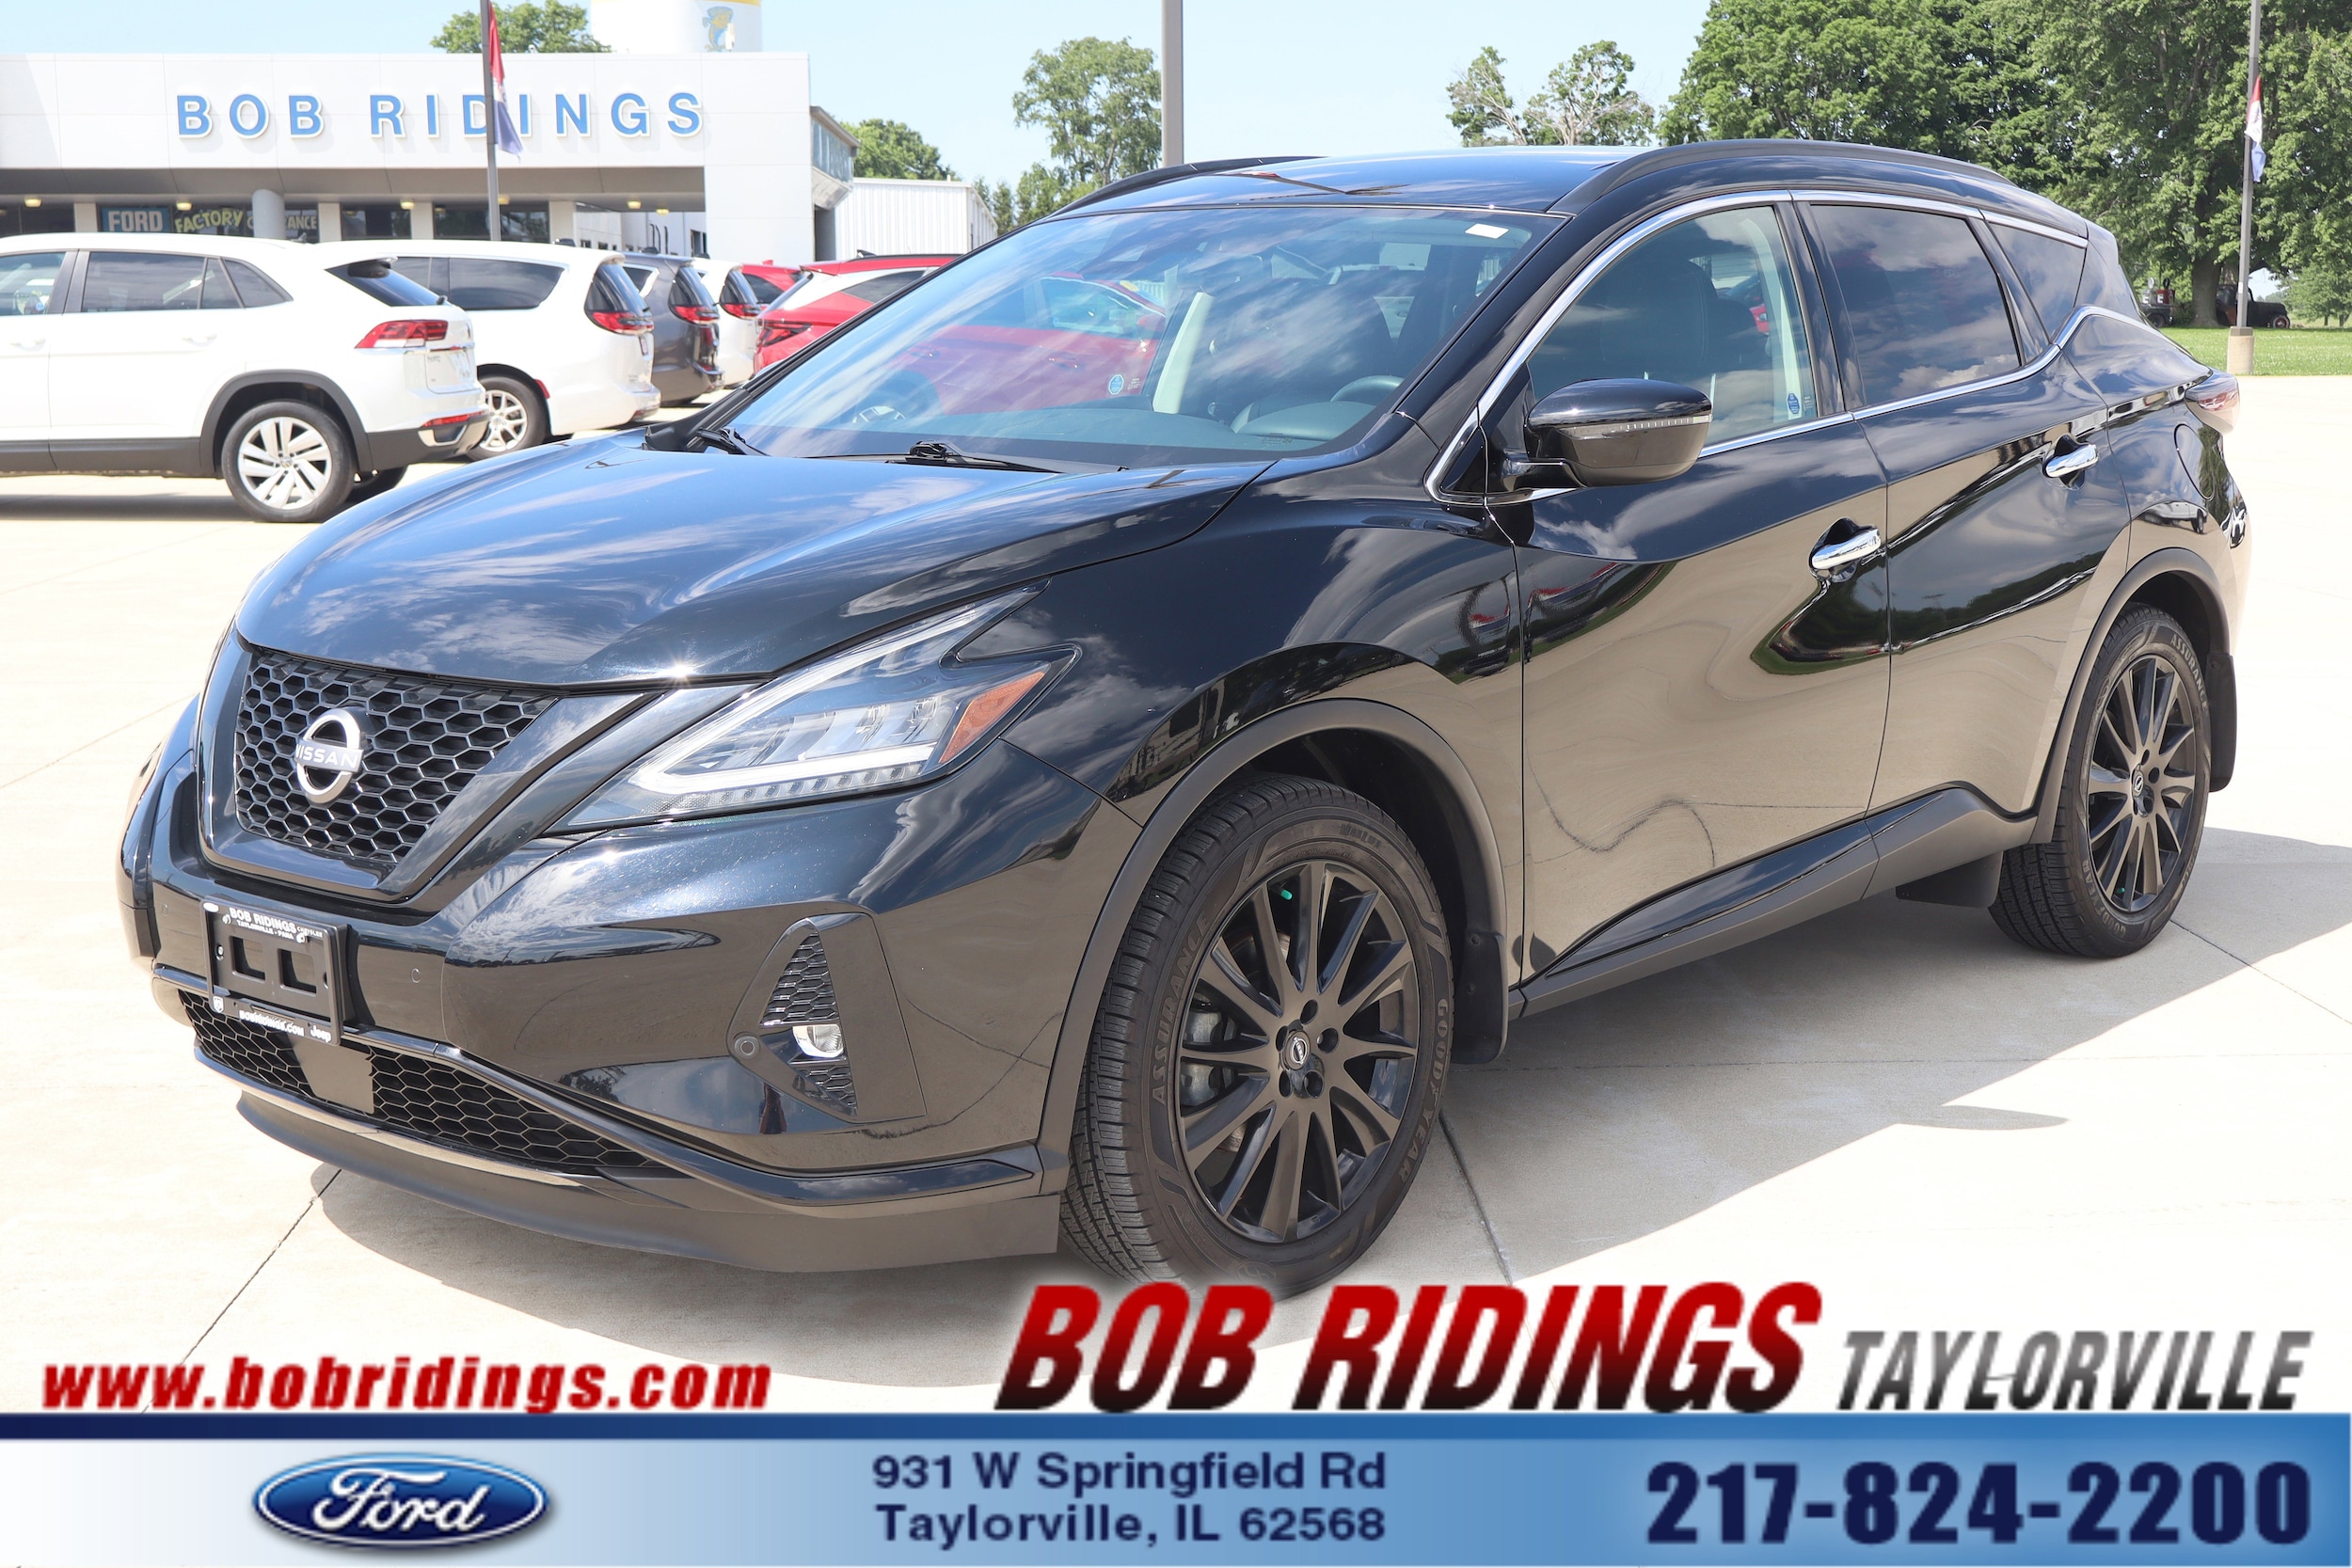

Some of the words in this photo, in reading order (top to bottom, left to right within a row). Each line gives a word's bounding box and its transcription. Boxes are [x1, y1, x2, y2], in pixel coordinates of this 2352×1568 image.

[176, 93, 325, 137] BOB
[370, 92, 703, 137] RIDINGS
[107, 209, 164, 232] FORD
[174, 208, 245, 233] FACTORY
[2169, 632, 2208, 712] ASSURANCE
[295, 743, 358, 768] NISSAN
[229, 907, 253, 923] BOB
[252, 912, 297, 933] RIDINGS
[1152, 910, 1210, 1106] ASSURANCE
[310, 1024, 332, 1043] Jeep
[1400, 998, 1449, 1183] GOODYEAR
